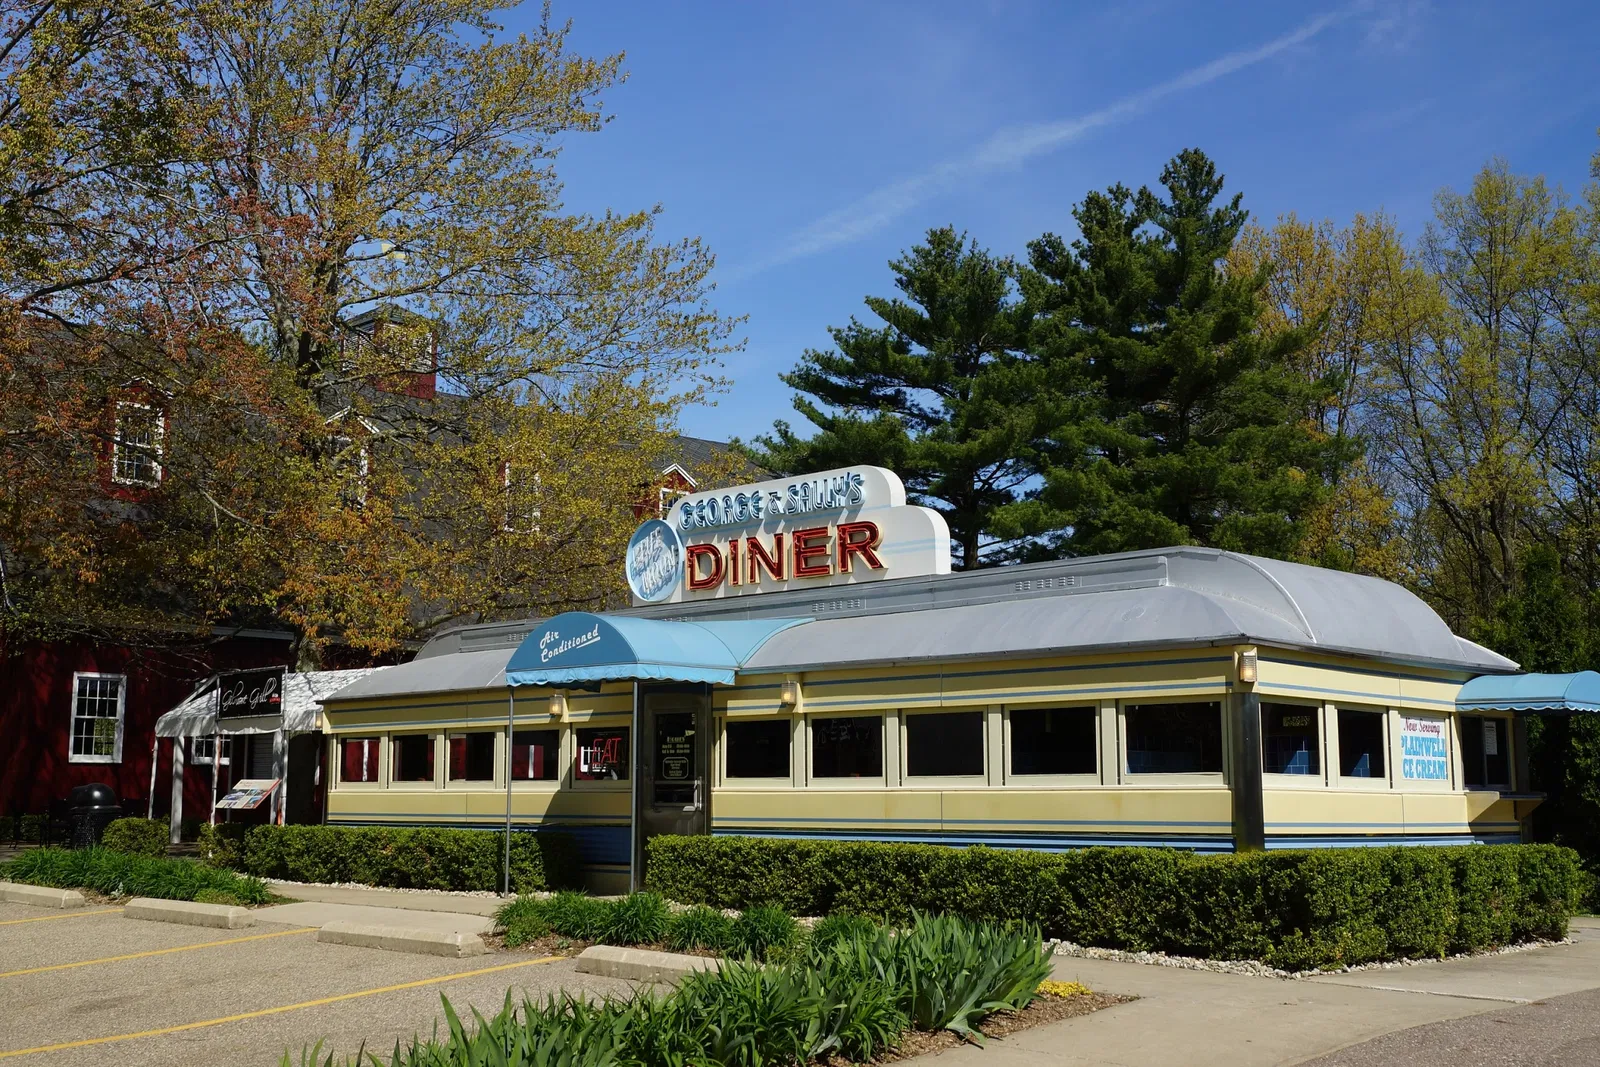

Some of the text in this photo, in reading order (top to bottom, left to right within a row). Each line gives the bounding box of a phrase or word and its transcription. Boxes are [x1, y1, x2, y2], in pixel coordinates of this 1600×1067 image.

[679, 472, 866, 531] GEORGE & SALLY'S
[686, 521, 888, 591] DINER
[540, 631, 559, 649] Air
[541, 624, 599, 662] Conditioned
[1404, 717, 1440, 737] Now Serving
[592, 737, 622, 765] EAT
[1403, 758, 1446, 779] CE CREAM
